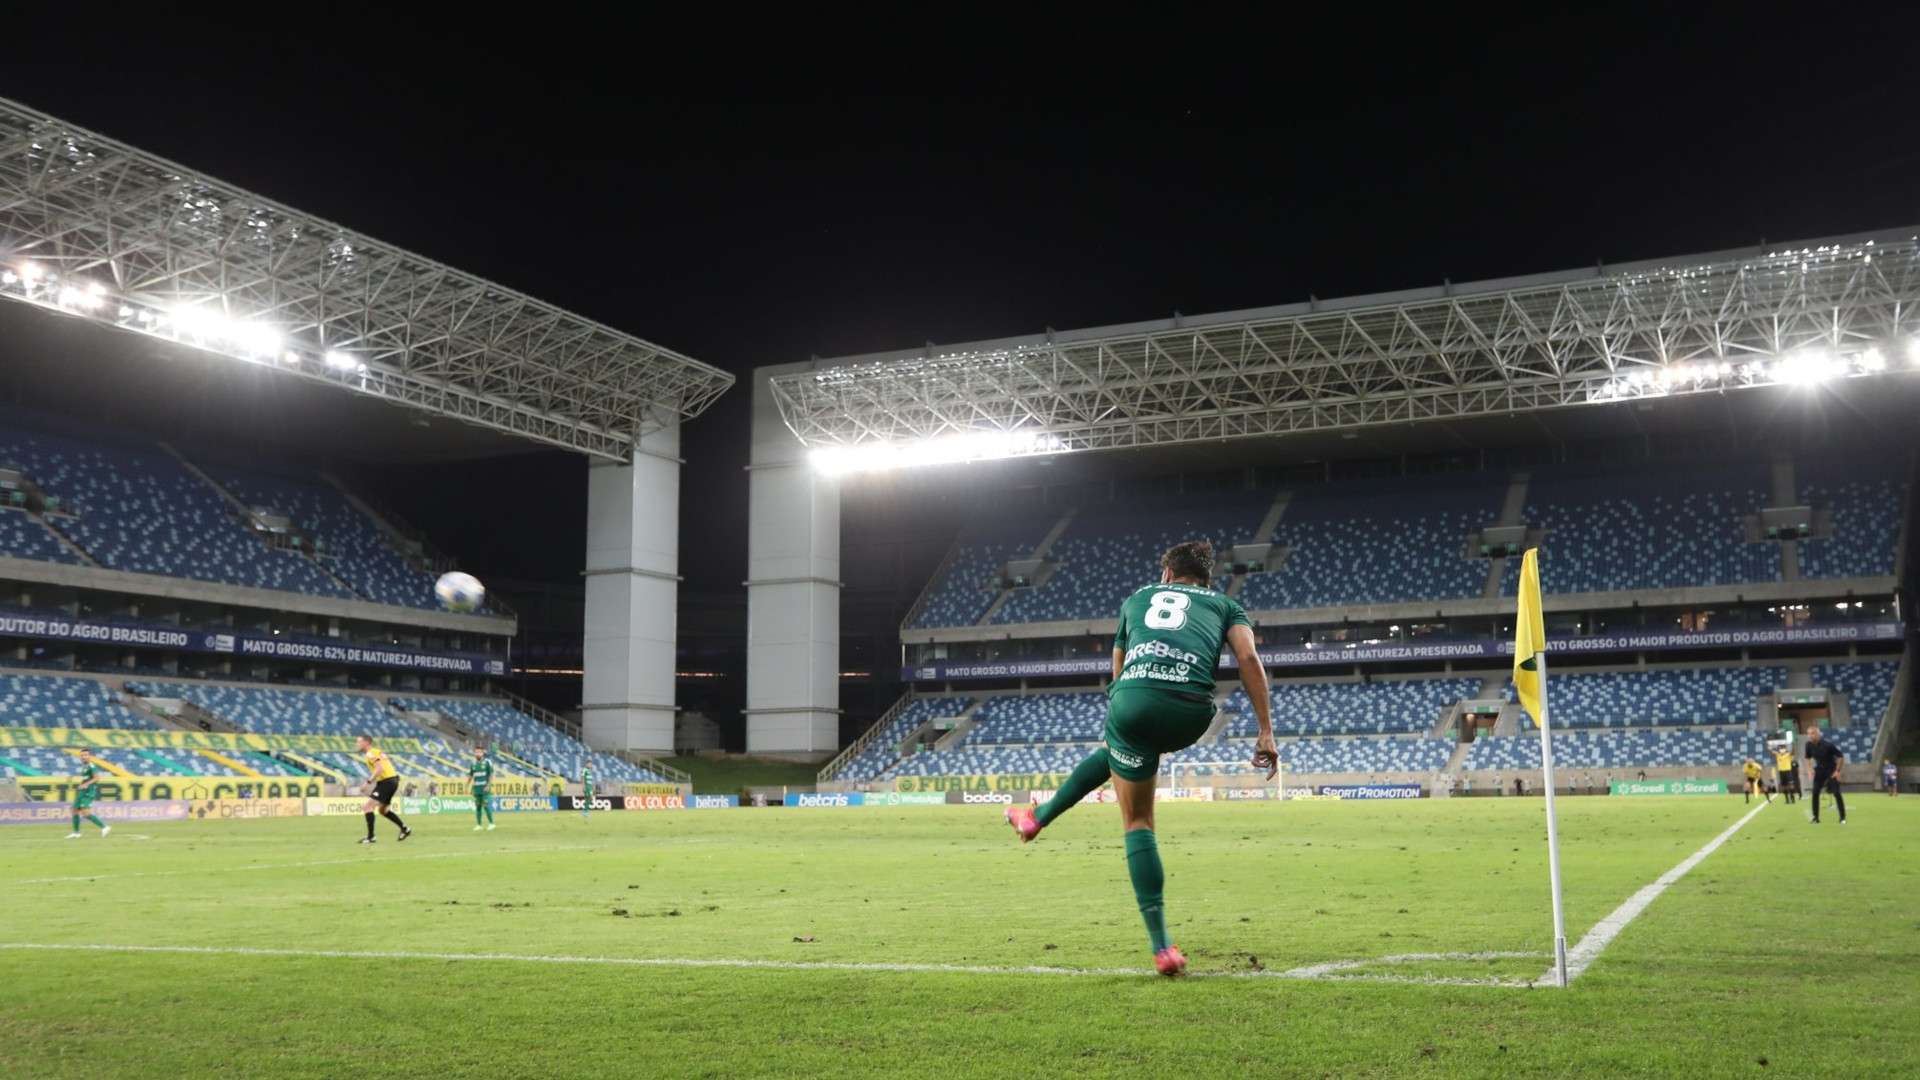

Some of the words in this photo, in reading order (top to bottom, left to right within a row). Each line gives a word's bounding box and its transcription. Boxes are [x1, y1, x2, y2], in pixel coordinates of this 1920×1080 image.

[1144, 591, 1191, 631] 8
[48, 622, 69, 636] DO
[71, 624, 109, 640] AGRO
[112, 628, 188, 646] BRASILEIRO
[1569, 638, 1617, 650] GROSSO:
[1618, 638, 1627, 648] O
[1629, 635, 1666, 648] MAIOR
[1668, 631, 1731, 646] PRODUTOR
[1733, 631, 1749, 642] DO
[1752, 629, 1784, 642] AGRO
[1786, 627, 1858, 640] BRASILEIRO
[243, 640, 275, 654] MATO
[276, 643, 323, 658] GROSSO:
[324, 646, 347, 660] 62%
[348, 649, 361, 661] DE
[362, 650, 413, 666] NATUREZA
[414, 655, 472, 670] PRESERVADA
[1274, 651, 1317, 662] GROSSO:
[1319, 650, 1340, 661] 62%
[1342, 650, 1355, 660] DE
[1358, 647, 1412, 659] NATUREZA
[1414, 644, 1483, 657] PRESERVADA
[945, 667, 970, 677] MATO
[971, 666, 1009, 676] GROSSO:
[1010, 666, 1017, 674] O
[1017, 664, 1046, 674] MAIOR
[1048, 662, 1096, 673] PRODUTOR
[1098, 661, 1111, 670] DO
[1148, 671, 1190, 683] GROSSO
[1322, 786, 1356, 799] SPORT
[1357, 785, 1420, 799] PROMOTION
[1630, 783, 1665, 794] Sicredi
[1683, 783, 1719, 793] Sicredi
[520, 798, 552, 810] SOCIAL
[624, 795, 646, 809] GOL
[646, 795, 666, 809] GOL
[666, 795, 685, 809] GOL
[695, 795, 729, 808] betcris
[798, 793, 848, 807] betcris
[963, 792, 1013, 804] bodog
[220, 800, 282, 817] betfair
